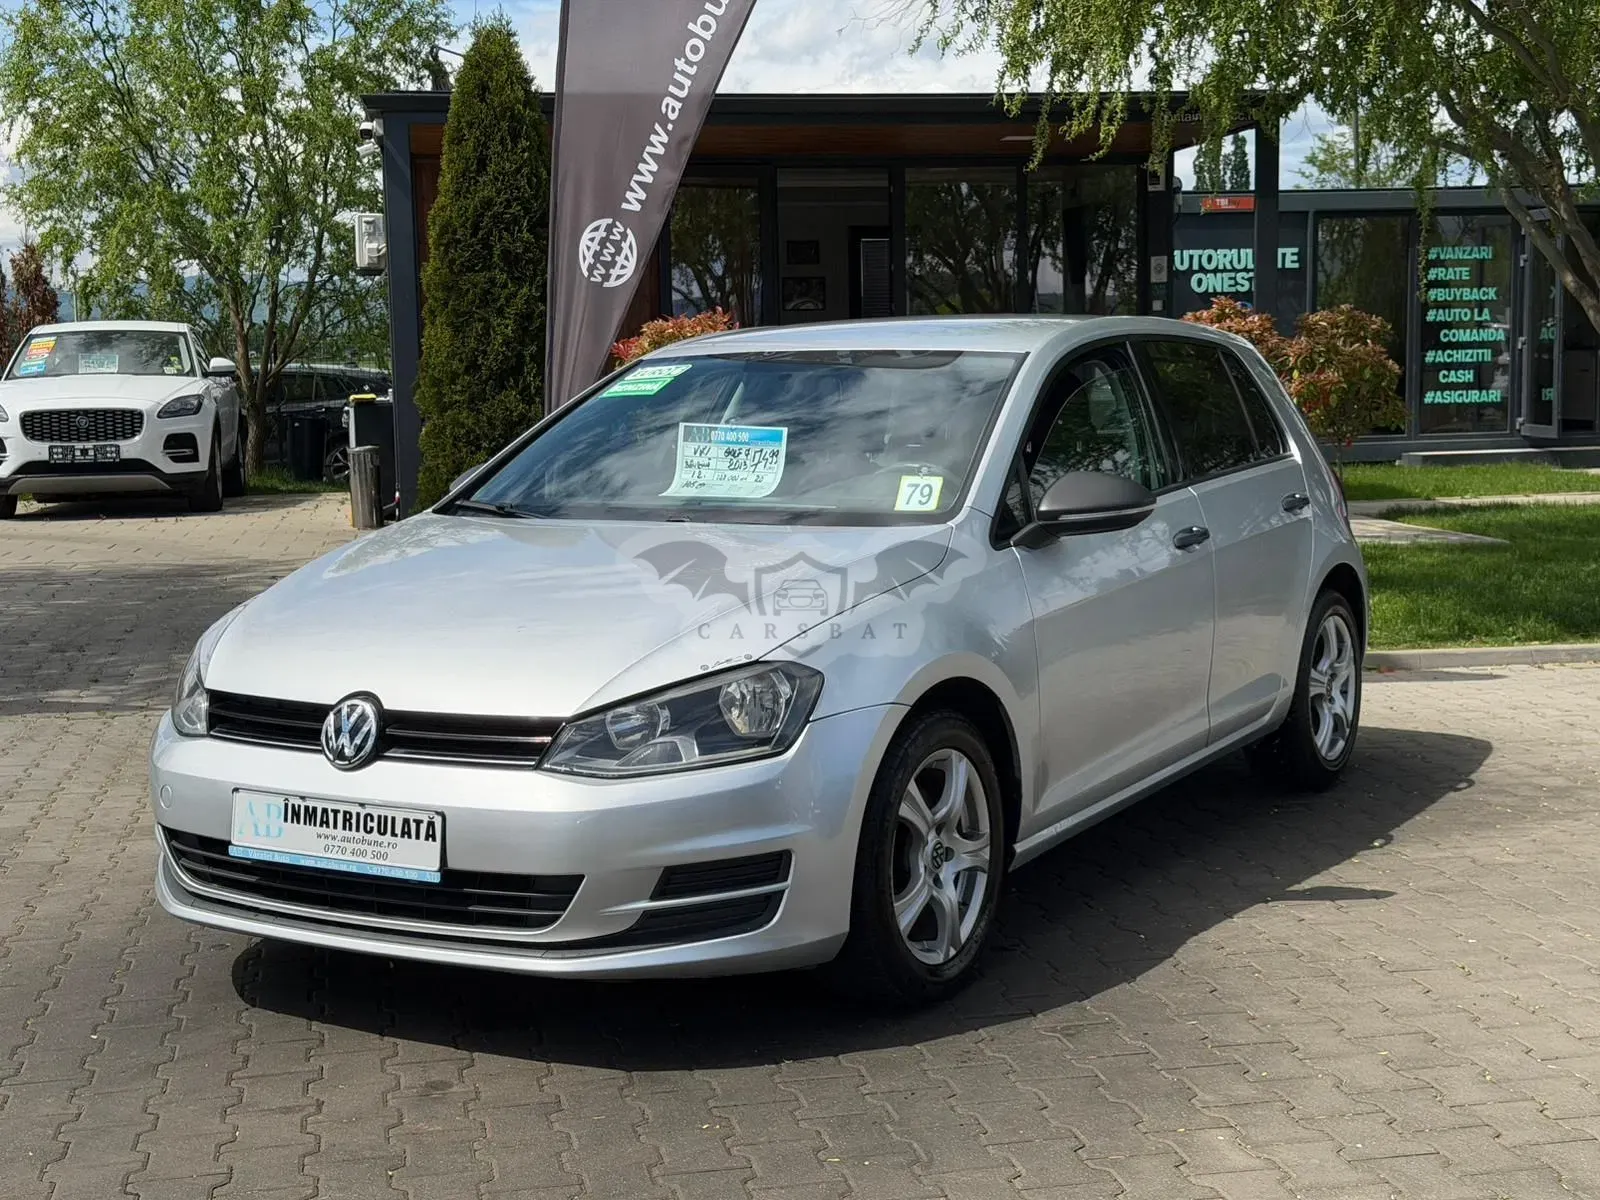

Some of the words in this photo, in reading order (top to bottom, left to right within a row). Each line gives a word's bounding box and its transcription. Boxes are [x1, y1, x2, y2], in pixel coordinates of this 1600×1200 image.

[1428, 246, 1493, 260] #VANZARI
[1427, 267, 1471, 281] #RATE
[1429, 287, 1498, 302] #BUYBACK
[1426, 308, 1471, 323] #AUTO
[1474, 308, 1491, 322] LA
[1440, 328, 1506, 342] COMANDA
[1424, 349, 1493, 364] #ACHIZITII
[1438, 369, 1475, 383] CASH
[1423, 389, 1502, 404] #ASIGURARI
[905, 483, 933, 506] 79
[283, 798, 438, 842] ÎNMATRICULATĂ
[315, 831, 398, 850] www.autobune.ro
[323, 844, 348, 856] 0770
[349, 847, 368, 859] 400
[370, 849, 389, 862] 500
